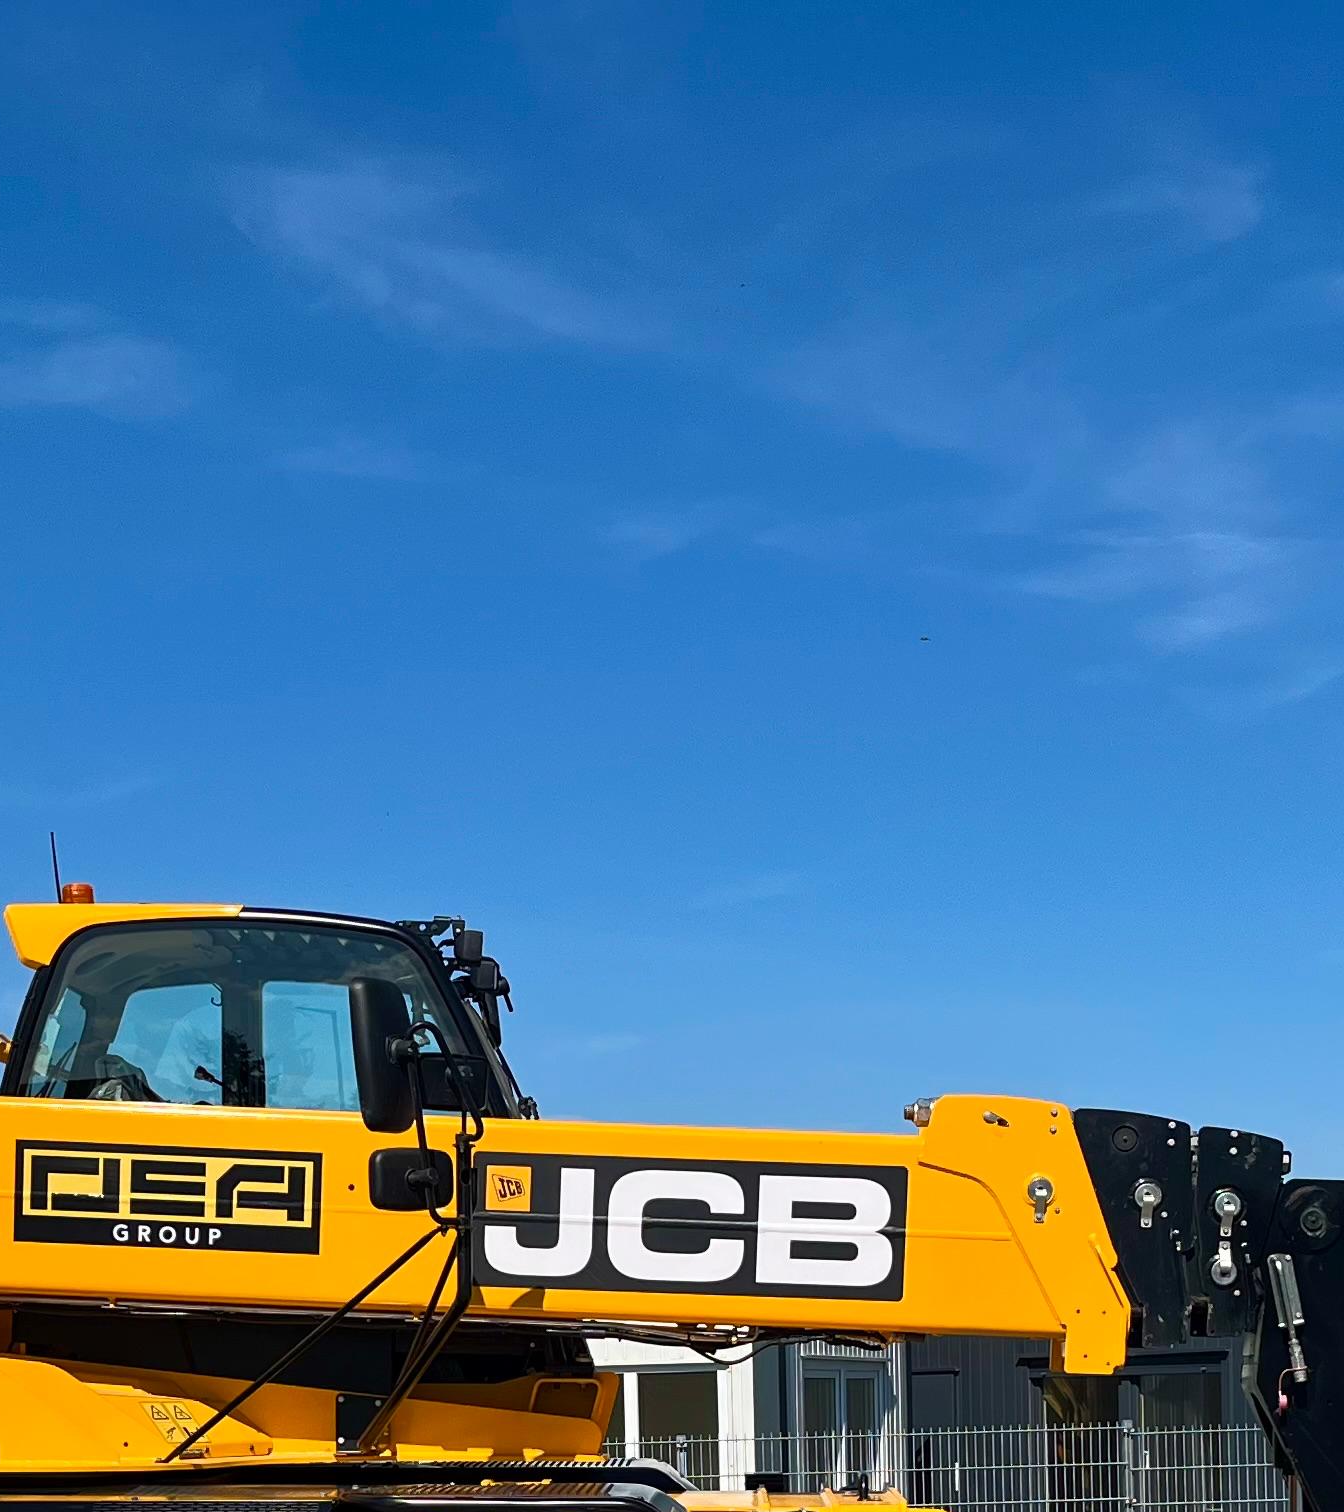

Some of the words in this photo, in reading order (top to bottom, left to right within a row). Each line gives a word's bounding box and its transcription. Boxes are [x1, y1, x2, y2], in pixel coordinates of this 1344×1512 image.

[497, 1176, 523, 1199] JCB
[112, 1223, 223, 1246] GROUP
[484, 1167, 893, 1286] JCB
